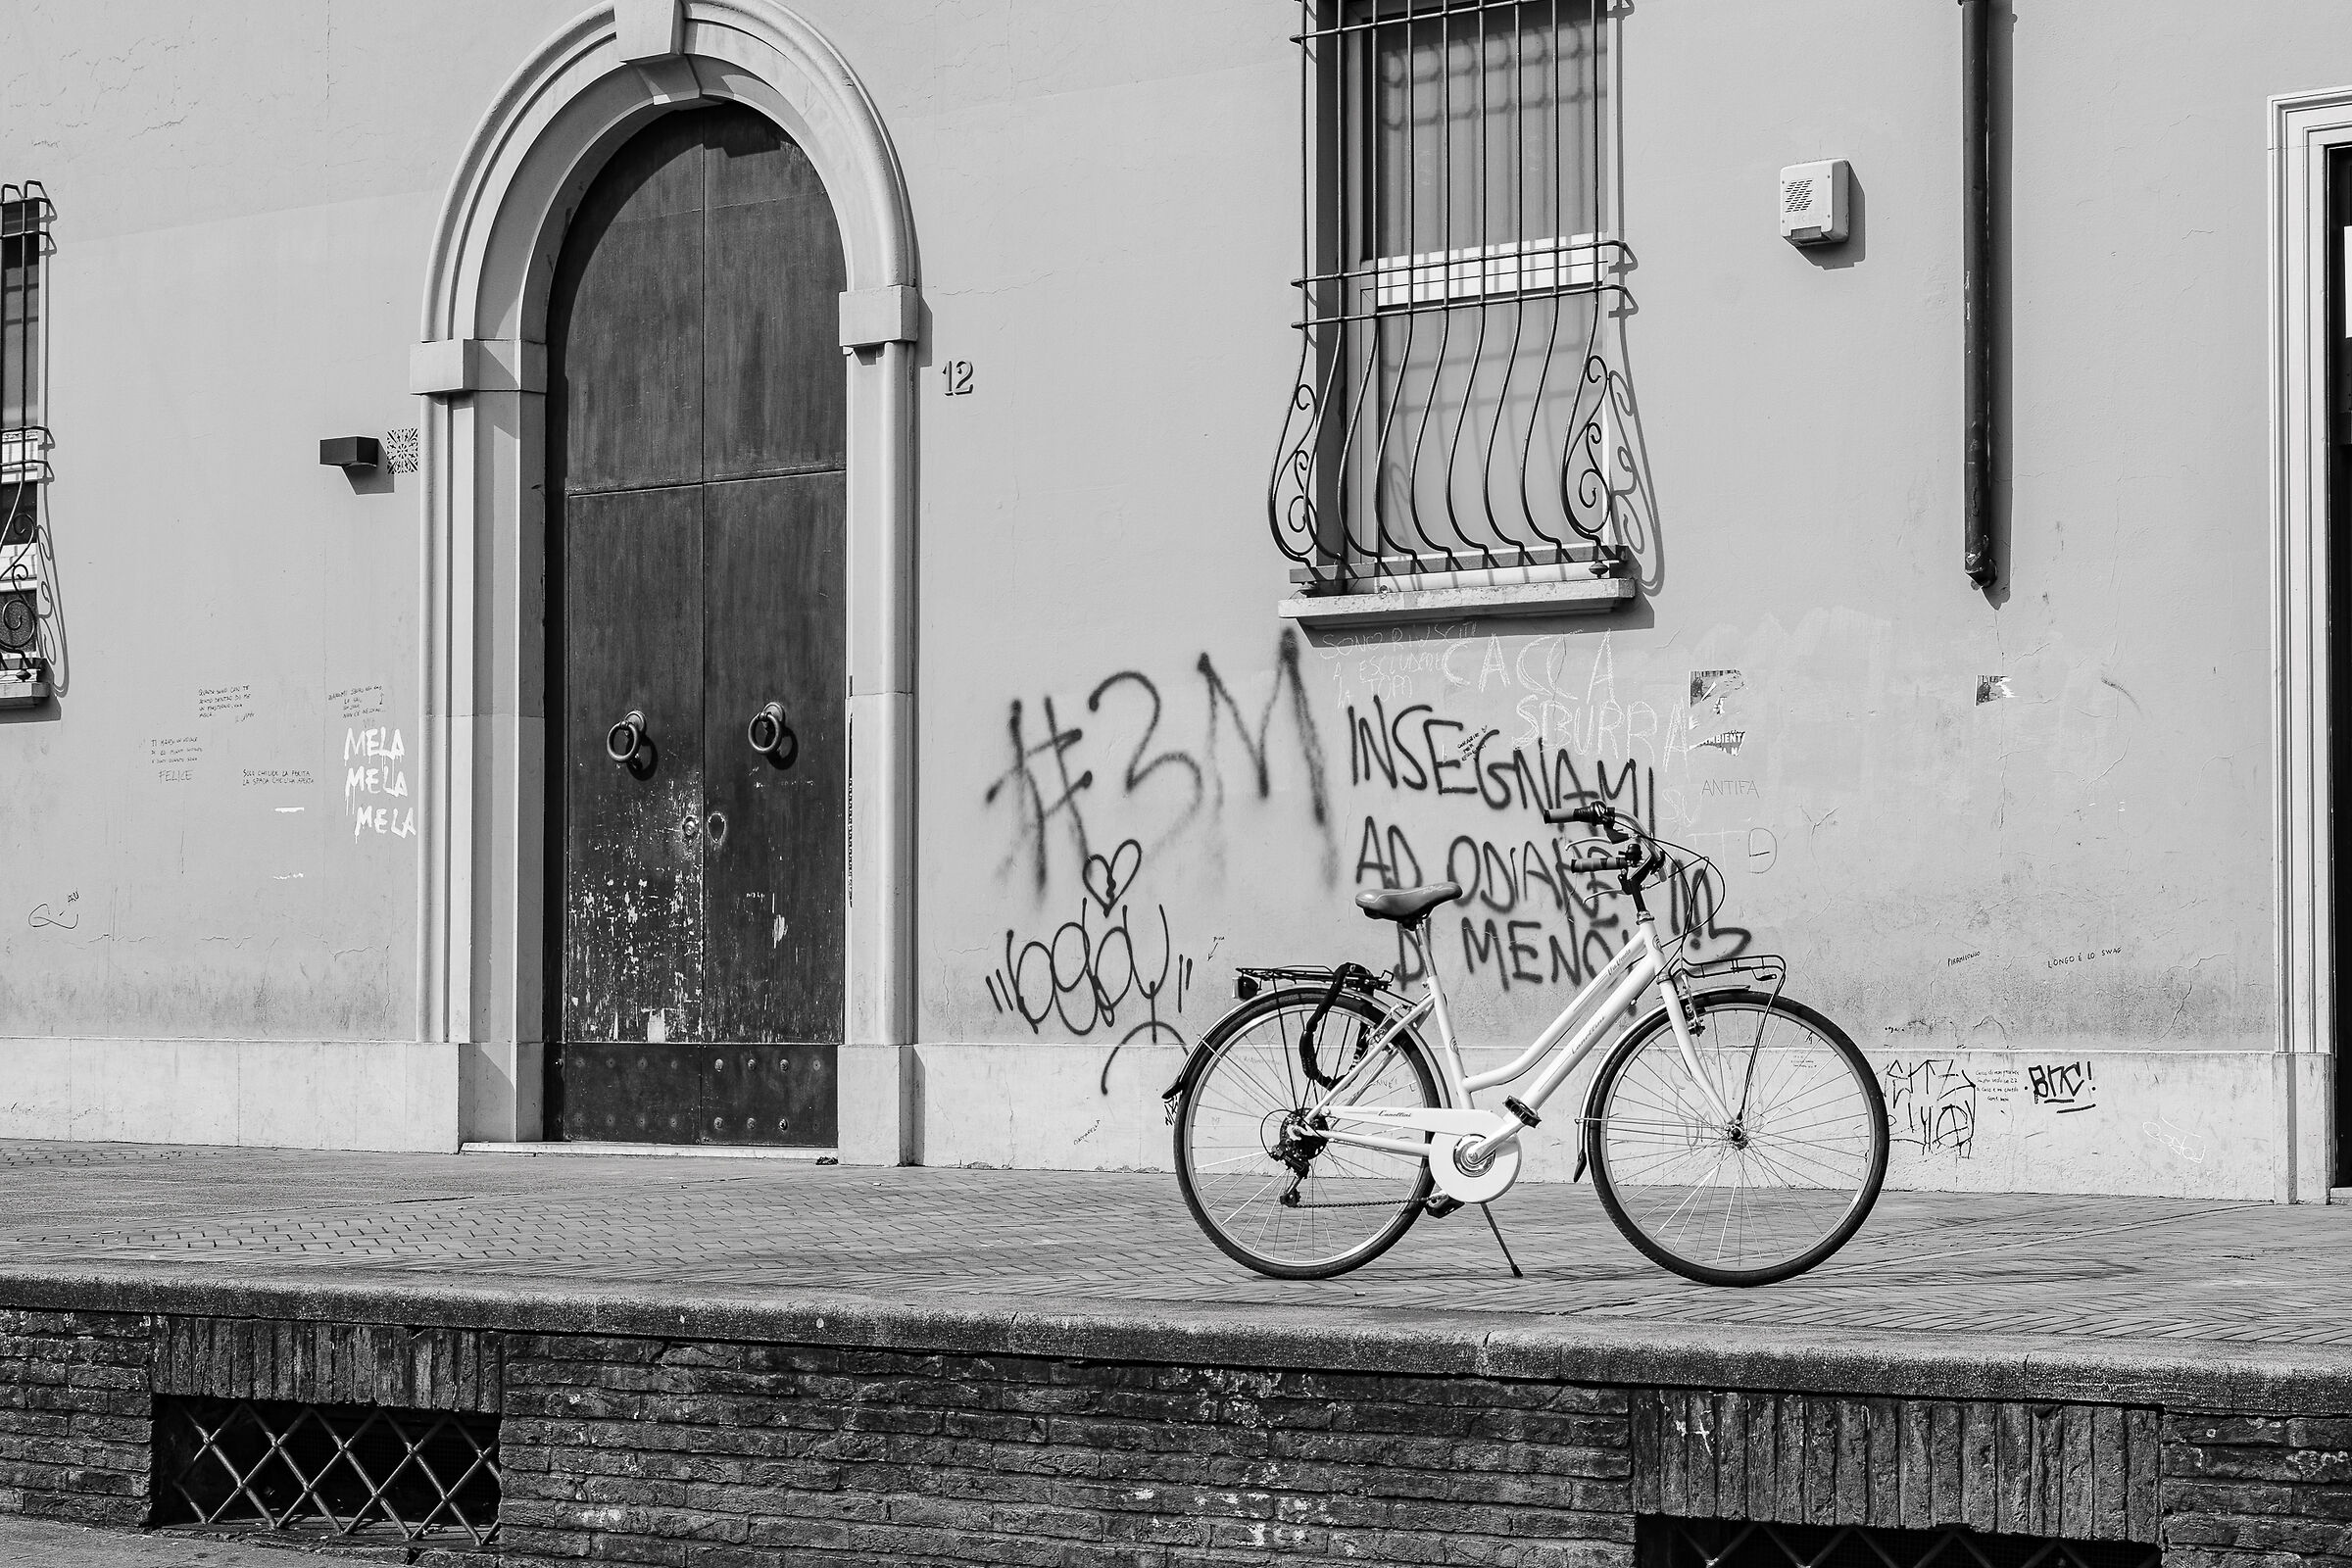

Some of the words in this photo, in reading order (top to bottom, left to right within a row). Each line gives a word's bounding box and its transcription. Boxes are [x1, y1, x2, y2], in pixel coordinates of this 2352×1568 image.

[942, 360, 973, 396] 12
[344, 726, 405, 762] MELA
[159, 770, 193, 784] FELICE
[1346, 694, 1656, 835] INSEGNAMI
[345, 765, 408, 799] MELA
[1702, 779, 1760, 799] ANTIFA
[355, 806, 416, 839] MELA
[2047, 956, 2075, 968] LONGO
[2101, 946, 2123, 956] SWAG
